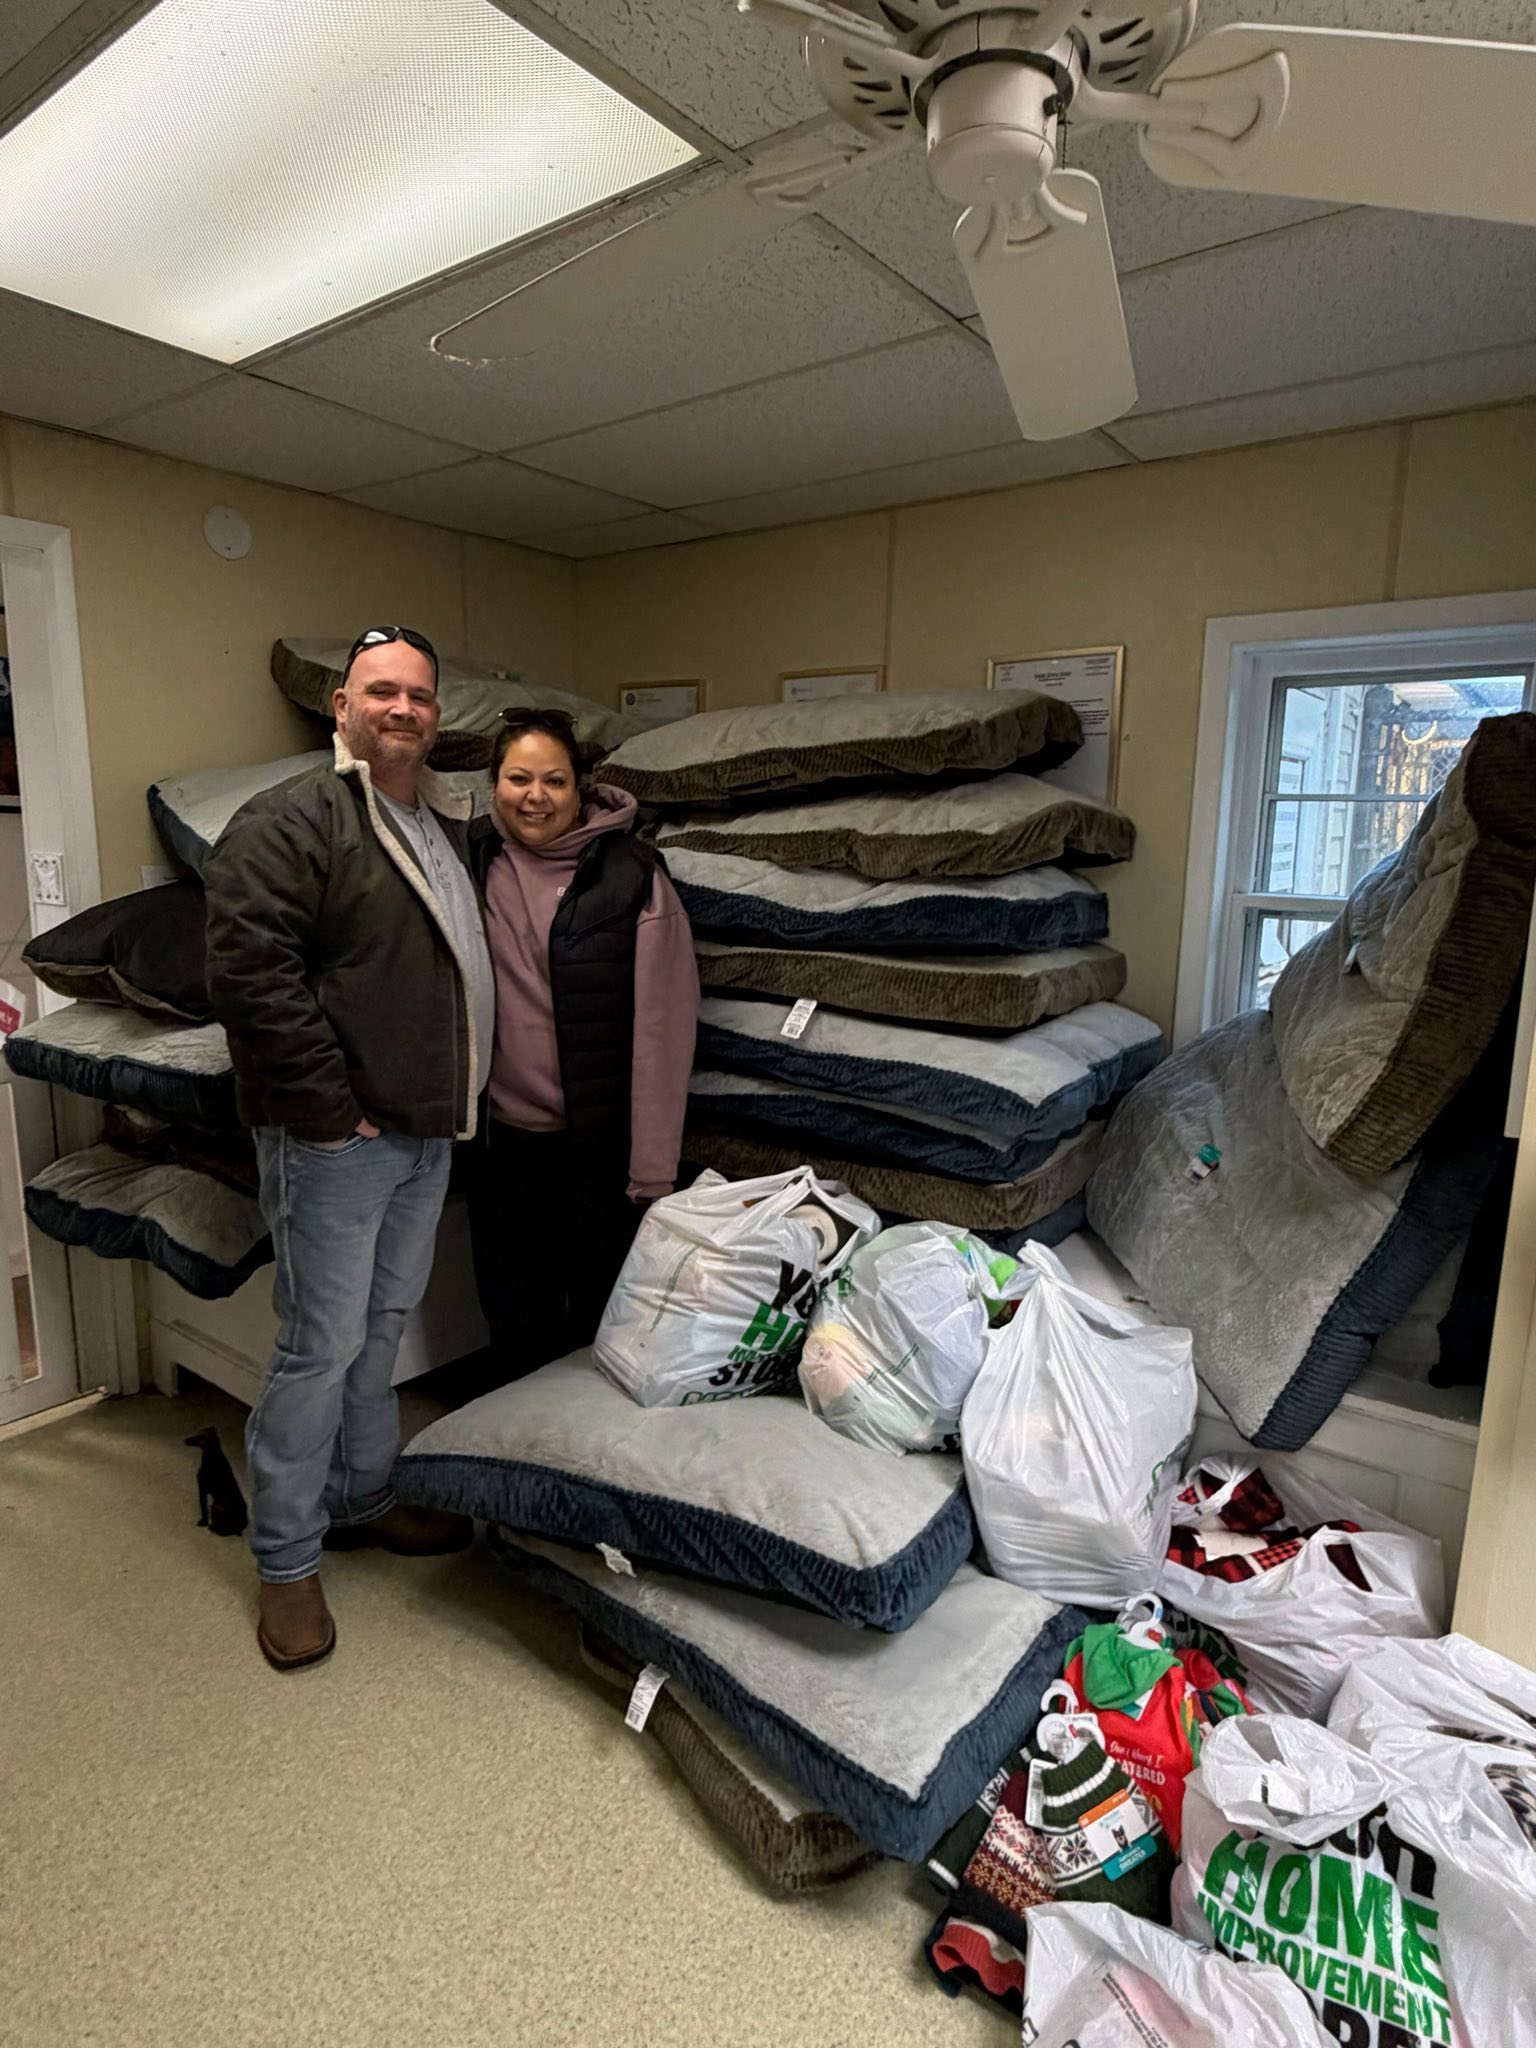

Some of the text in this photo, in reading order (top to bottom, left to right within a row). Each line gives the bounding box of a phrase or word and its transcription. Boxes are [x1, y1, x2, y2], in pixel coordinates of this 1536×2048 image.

[1115, 1757, 1166, 1786] ATERED
[1197, 1890, 1452, 2046] IMPROVEMENT
[1203, 1829, 1451, 2002] HOME
